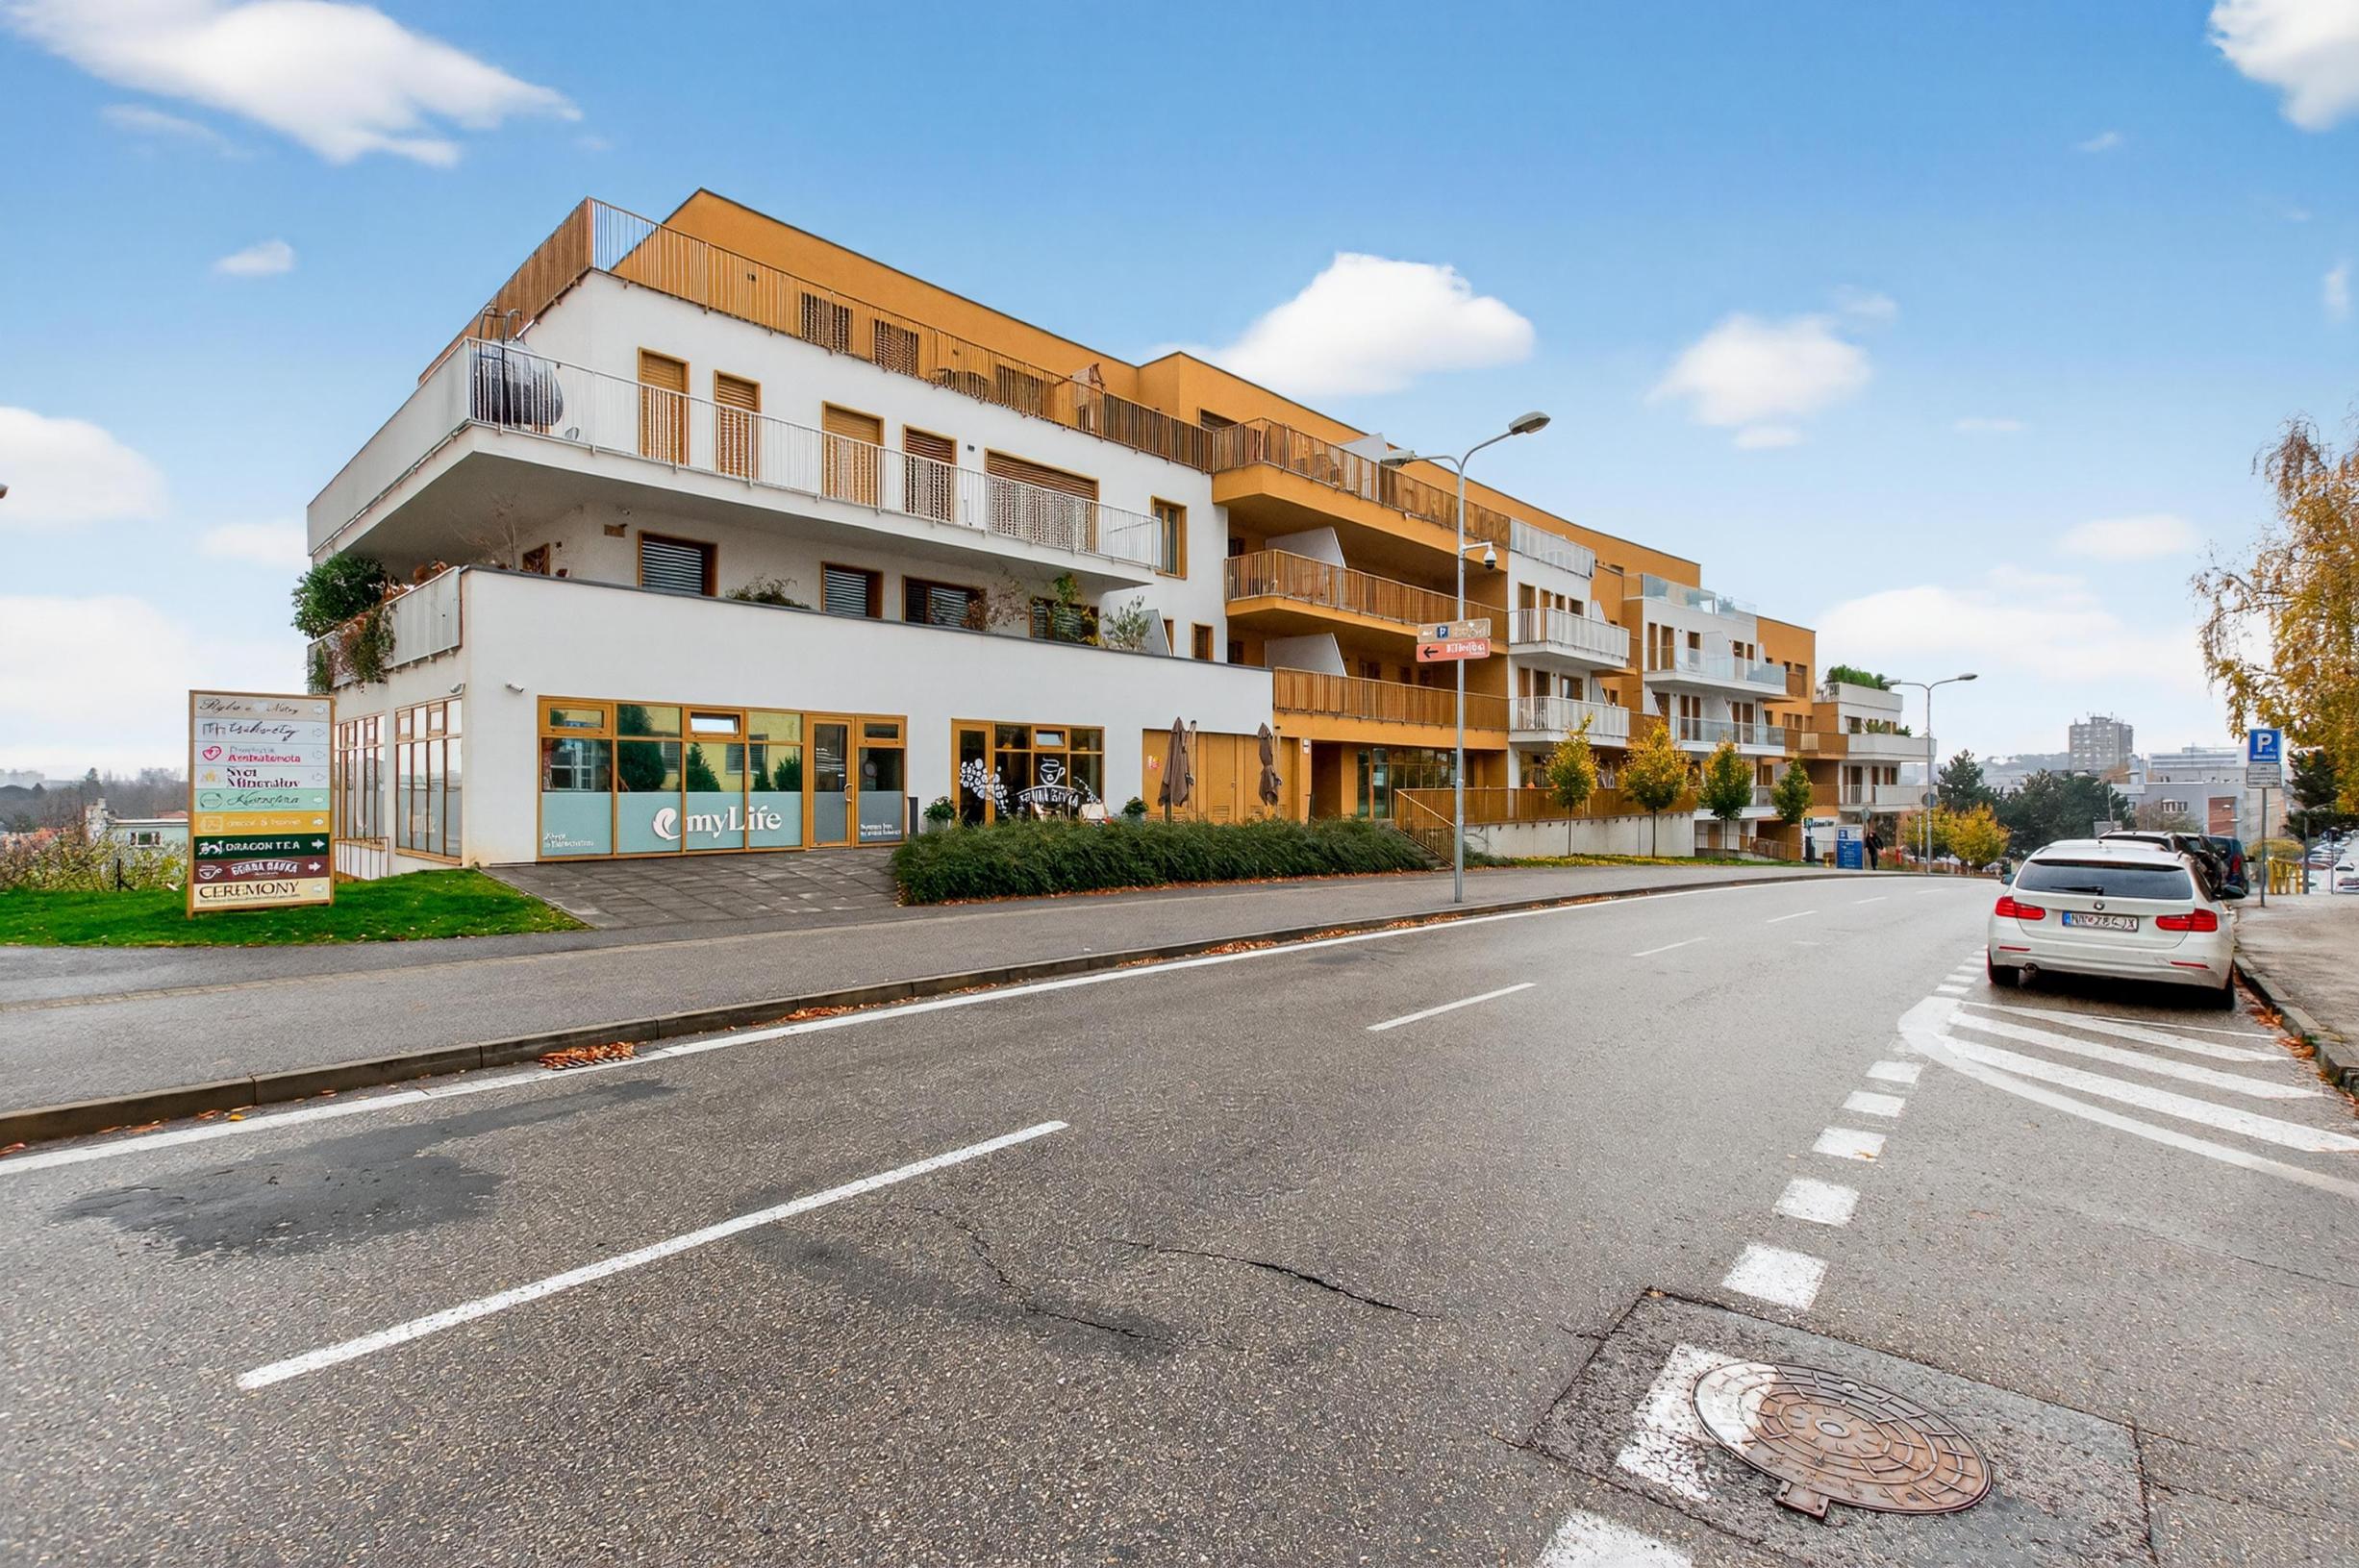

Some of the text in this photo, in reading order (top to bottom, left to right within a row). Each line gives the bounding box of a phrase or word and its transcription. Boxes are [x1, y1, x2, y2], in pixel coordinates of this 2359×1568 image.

[2257, 733, 2272, 753] P
[686, 804, 783, 839] myLife
[226, 840, 300, 852] DRAGON TEA
[199, 882, 299, 899] CEREMONY
